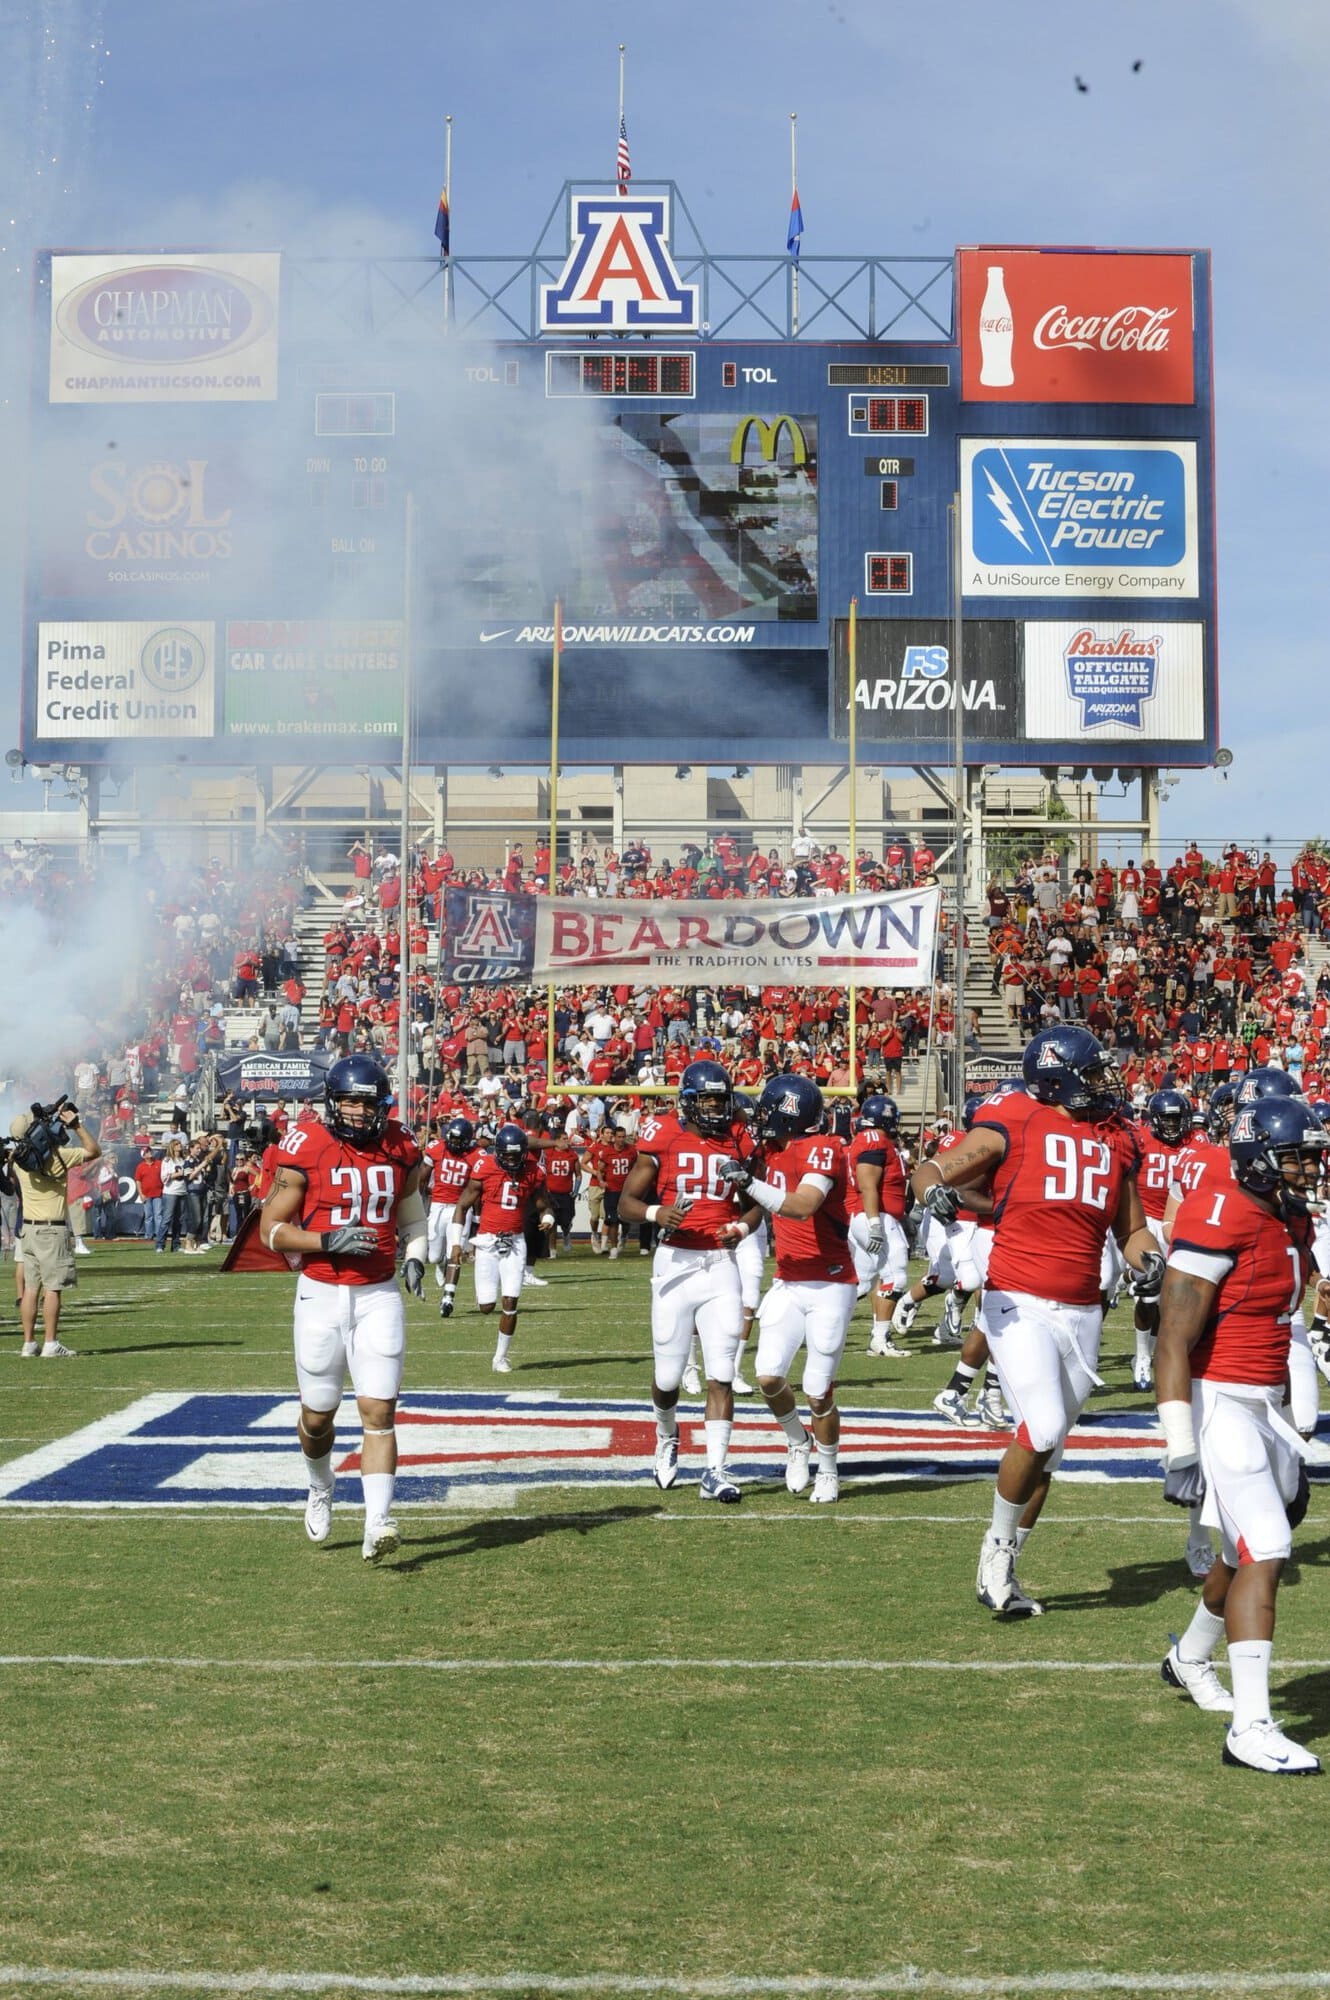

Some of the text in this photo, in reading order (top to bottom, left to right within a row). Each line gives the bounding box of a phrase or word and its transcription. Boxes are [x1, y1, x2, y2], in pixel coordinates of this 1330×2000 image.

[93, 288, 233, 328] CHAPMAN
[97, 327, 232, 342] AUTOMOTIVE
[1032, 304, 1178, 352] Coca-Cola
[65, 375, 262, 390] CHAPMANTUCSON.COM
[465, 367, 499, 383] TOL
[741, 367, 778, 384] TOL
[867, 367, 907, 385] WSU
[878, 458, 901, 475] QTR
[1026, 462, 1136, 492] Tucson
[85, 459, 233, 529] SOL
[1036, 493, 1166, 521] Electric
[85, 531, 233, 560] CASINOS
[1050, 521, 1165, 550] Power
[871, 558, 907, 588] 25
[971, 572, 1186, 591] A UniSource Energy Company
[47, 641, 106, 660] Pima
[1067, 631, 1160, 656] Bashas'
[231, 652, 265, 671] CAR
[901, 645, 949, 679] FS
[1073, 661, 1150, 673] OFFICIAL
[47, 671, 135, 691] Federal
[1073, 674, 1150, 686] TAILGATE
[846, 679, 997, 711] ARIZONA
[1074, 686, 1149, 695] HEADQUARTERS
[46, 701, 197, 721] Credit Union
[1087, 703, 1137, 713] ARIZONA
[230, 719, 398, 734] www.brakemax.com
[656, 954, 813, 968] THE TRADITION LIVES
[452, 963, 521, 982] CLUB
[966, 1064, 1024, 1072] AMERICAN FAM
[473, 1159, 485, 1173] 6
[551, 1160, 569, 1177] 63
[612, 1158, 629, 1175] 32
[806, 1146, 835, 1171] 43
[440, 1158, 468, 1187] 52
[1044, 1133, 1112, 1210] 92
[1180, 1161, 1208, 1190] 47
[330, 1165, 395, 1227] 38
[501, 1181, 518, 1210] 6
[1205, 1192, 1227, 1227] 1
[1276, 1246, 1302, 1325] 1
